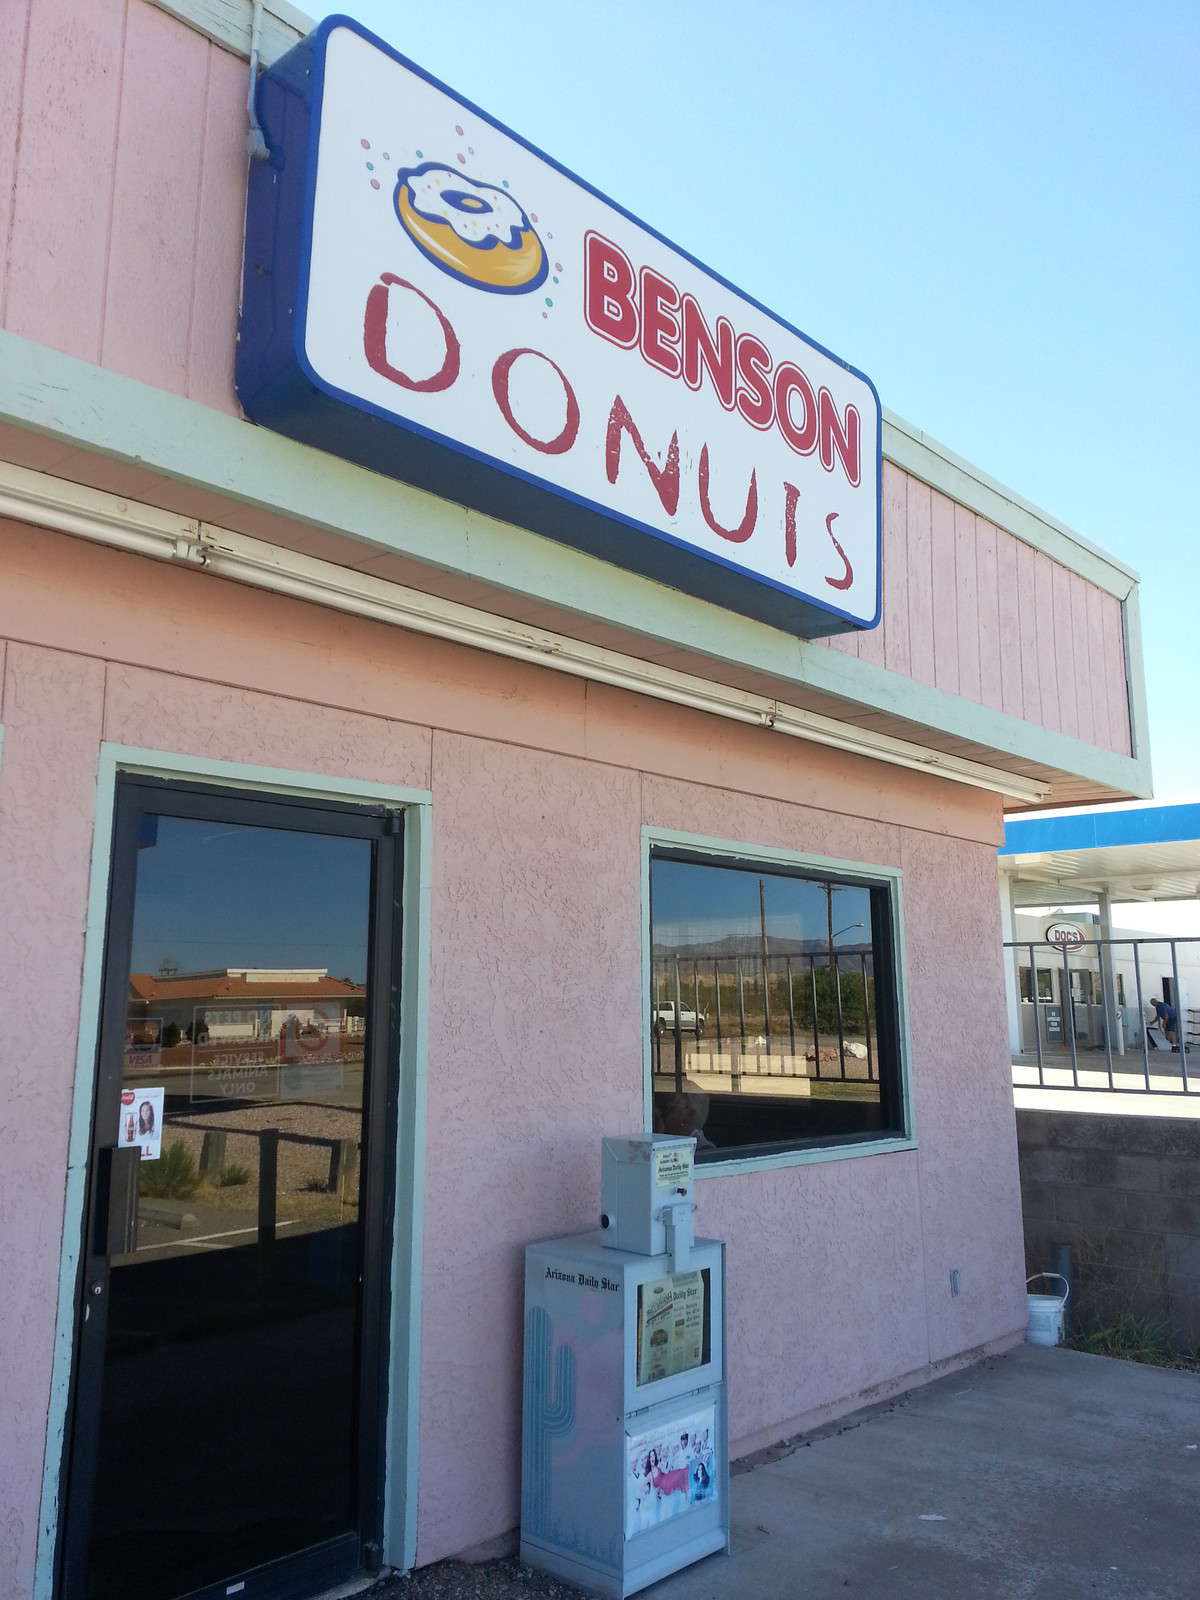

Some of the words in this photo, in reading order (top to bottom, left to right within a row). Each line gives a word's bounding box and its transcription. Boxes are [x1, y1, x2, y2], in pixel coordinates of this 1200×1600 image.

[363, 271, 855, 591] DONUTS
[583, 229, 862, 488] BENSON
[545, 1266, 576, 1283] Arizona
[577, 1273, 599, 1289] Daily
[600, 1277, 620, 1292] Star
